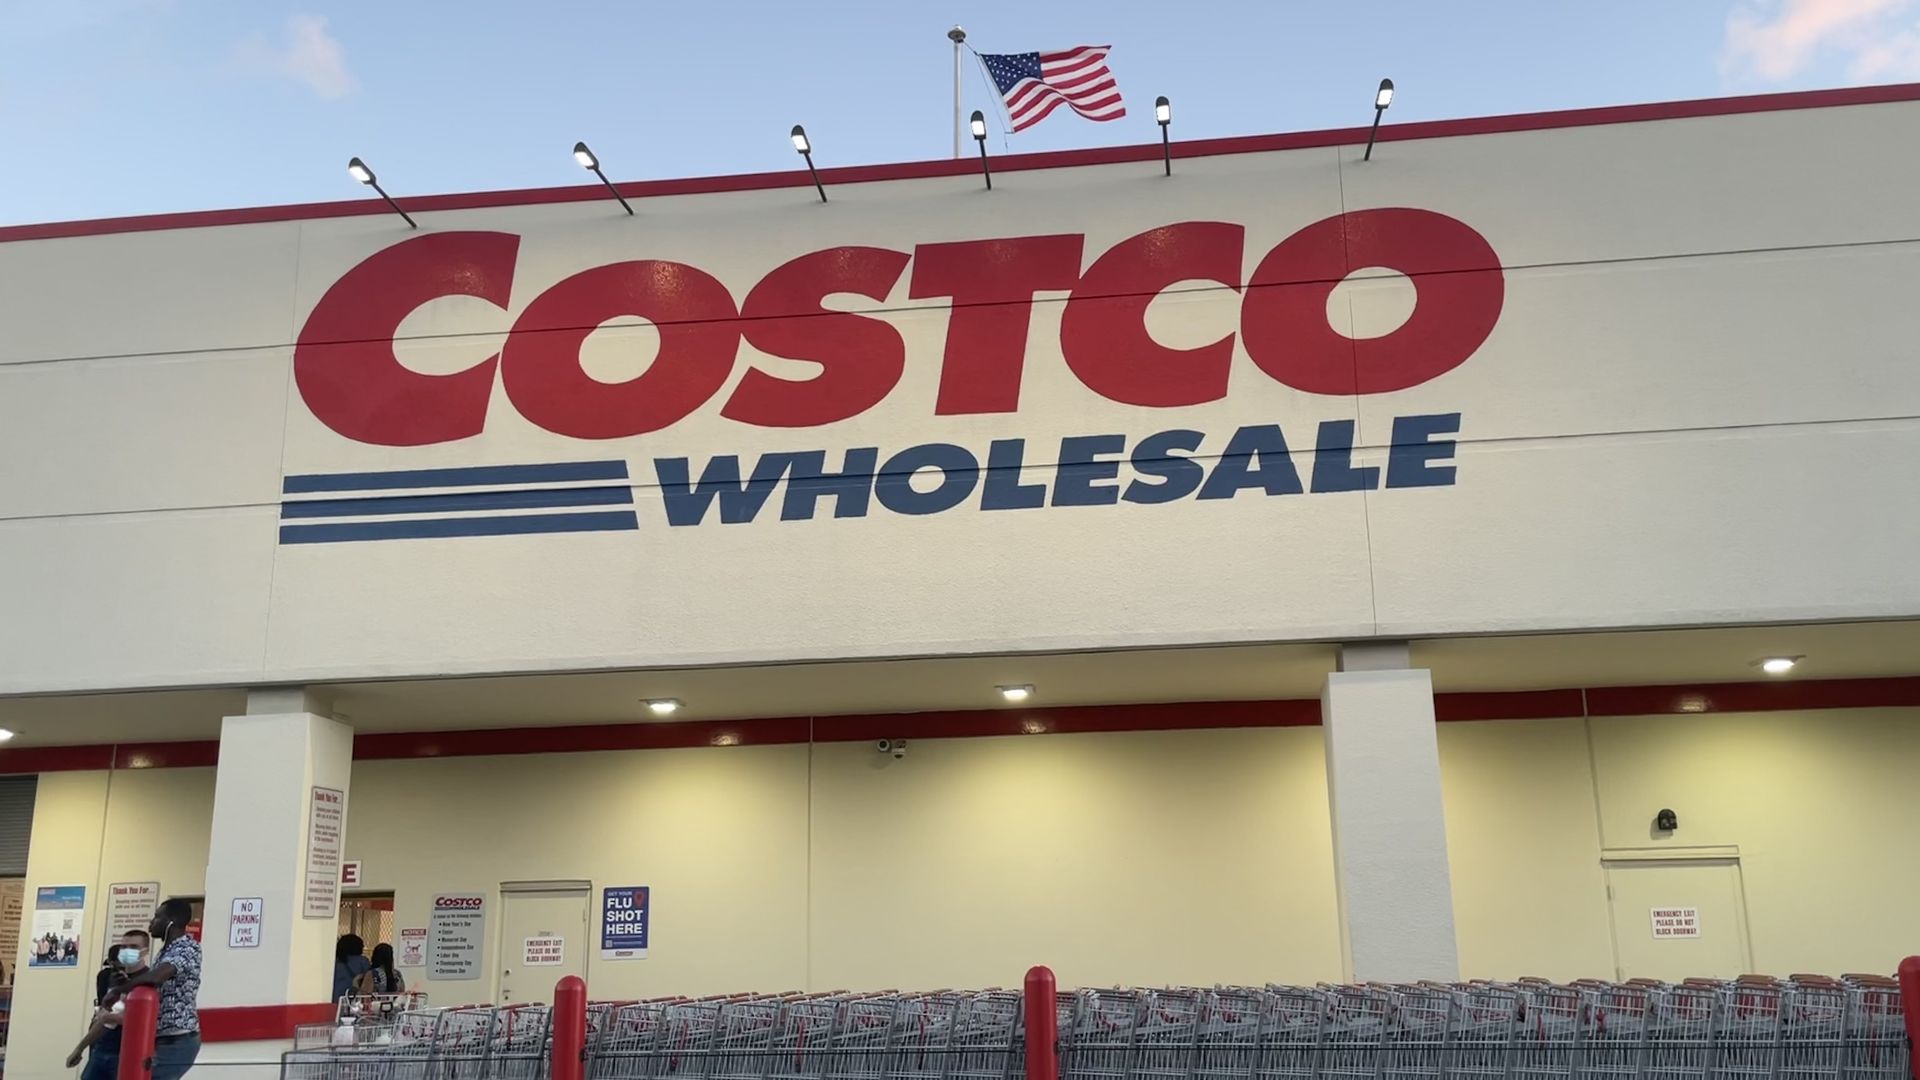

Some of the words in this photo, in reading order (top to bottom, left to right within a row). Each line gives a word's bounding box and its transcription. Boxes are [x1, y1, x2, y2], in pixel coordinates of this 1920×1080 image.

[294, 207, 1504, 446] COSTCO
[654, 413, 1461, 526] WHOLESALE
[241, 902, 253, 912] NO
[435, 896, 482, 906] COSTCO
[607, 897, 632, 909] FLU
[232, 914, 259, 924] PARKING
[606, 910, 643, 922] SHOT
[237, 927, 252, 935] FIRE
[606, 922, 643, 935] HERE
